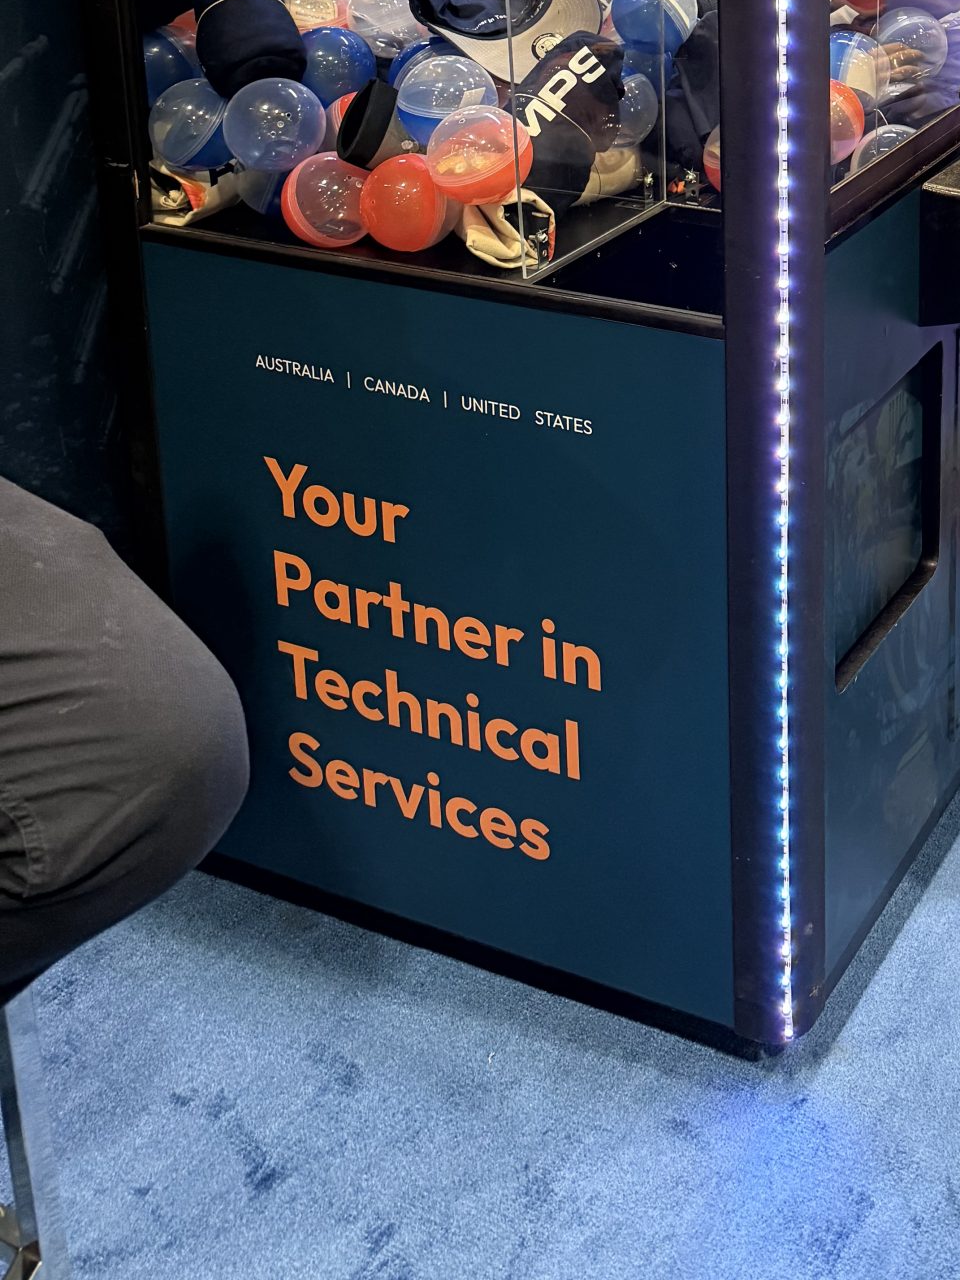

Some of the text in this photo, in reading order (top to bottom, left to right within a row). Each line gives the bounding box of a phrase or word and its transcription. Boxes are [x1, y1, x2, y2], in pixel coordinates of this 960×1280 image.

[521, 46, 606, 137] MPS
[255, 354, 593, 436] AUSTRALIA CANADA UNITED STATES
[263, 456, 410, 543] Your
[274, 550, 602, 692] Partner in
[277, 640, 580, 781] Technical
[288, 731, 551, 860] Services
